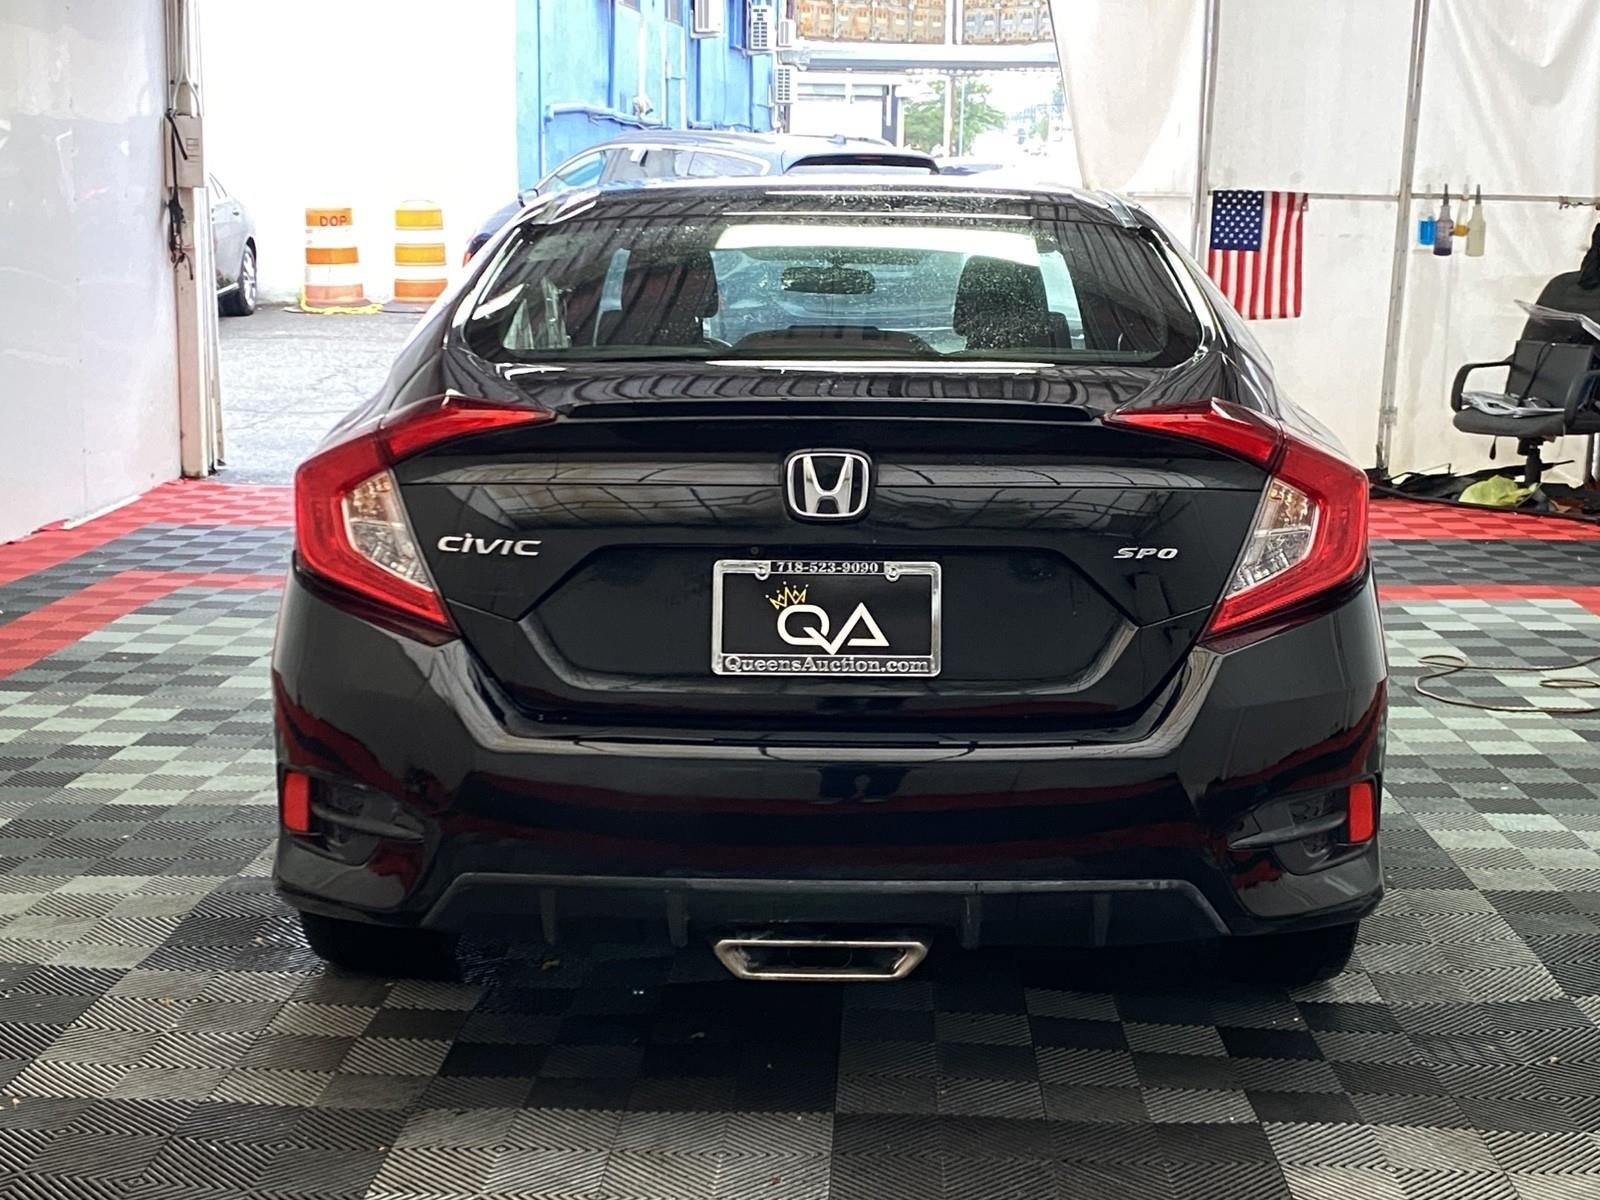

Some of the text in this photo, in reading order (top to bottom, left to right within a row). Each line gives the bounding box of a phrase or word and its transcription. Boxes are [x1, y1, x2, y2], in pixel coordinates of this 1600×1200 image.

[1112, 547, 1179, 559] SPO
[776, 562, 879, 573] 718-523-9090
[776, 602, 890, 656] QA
[724, 656, 929, 674] QueensAuction.com
